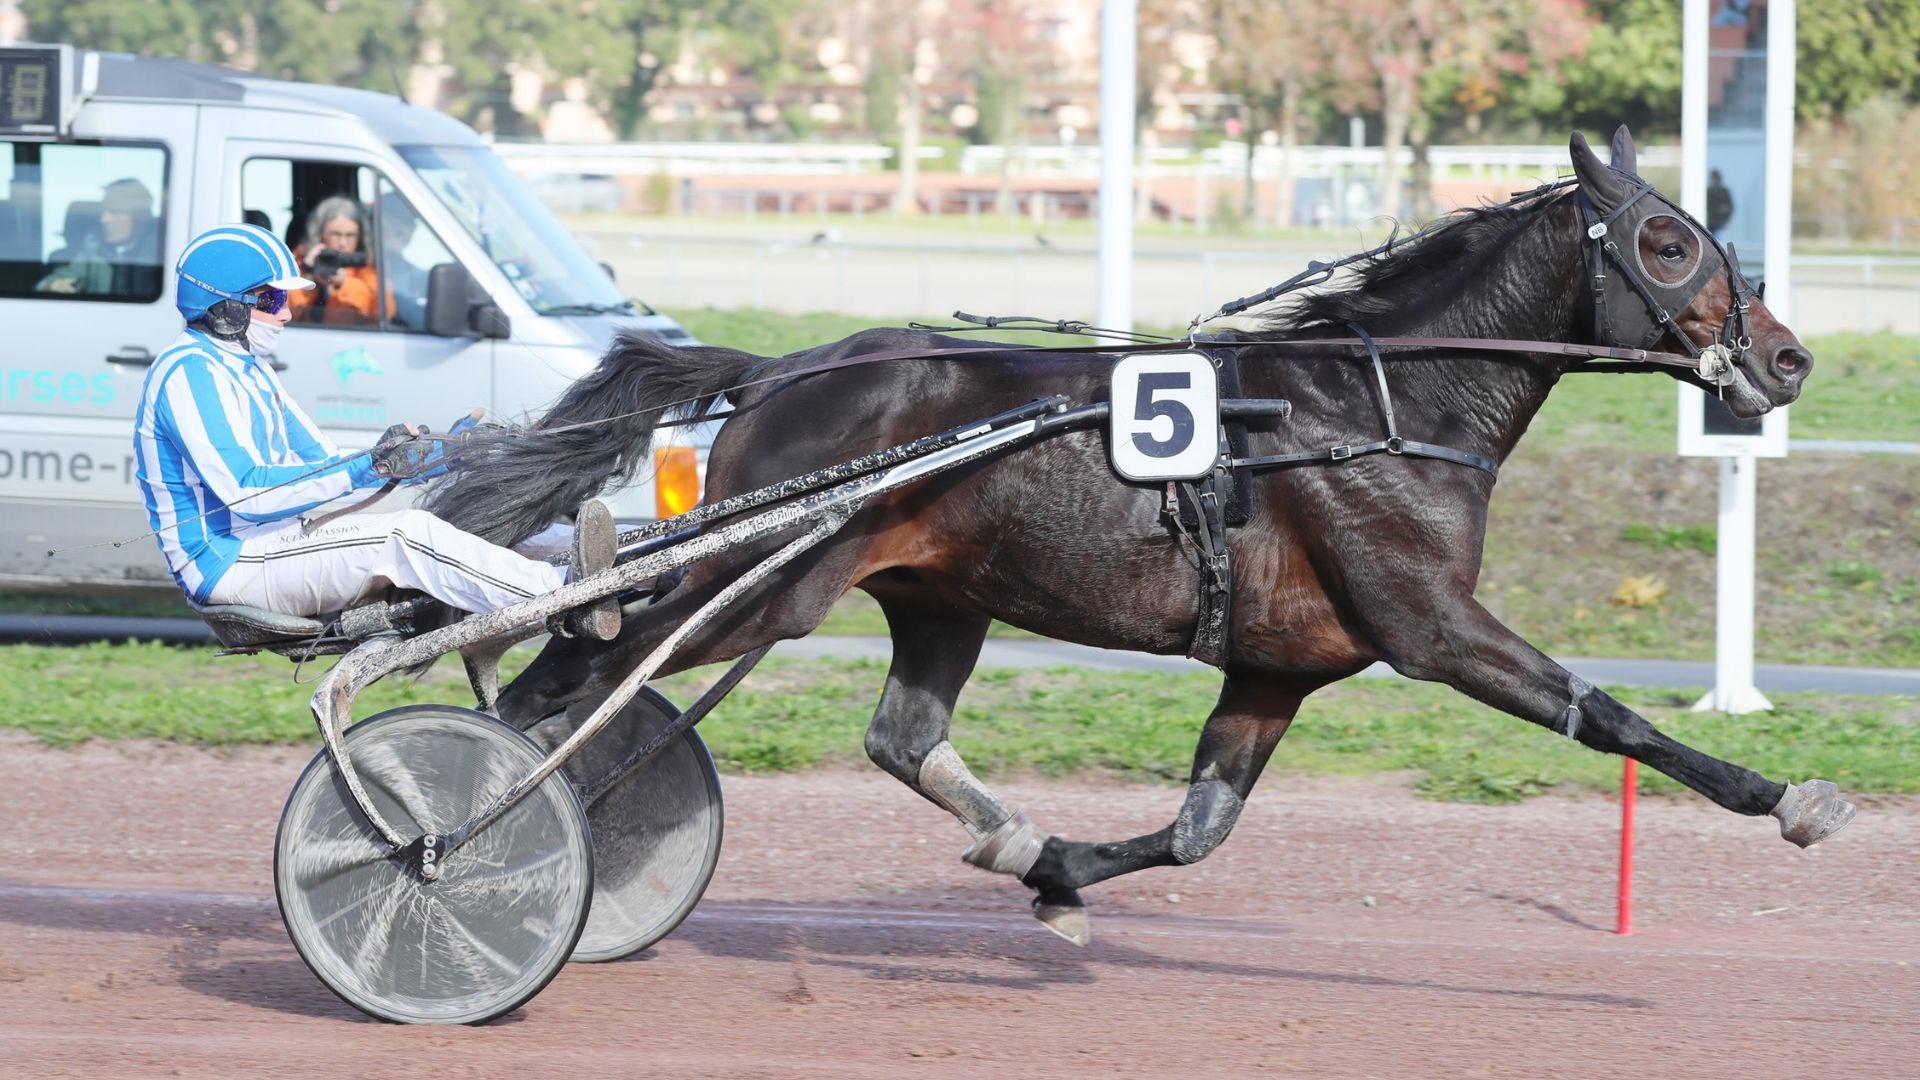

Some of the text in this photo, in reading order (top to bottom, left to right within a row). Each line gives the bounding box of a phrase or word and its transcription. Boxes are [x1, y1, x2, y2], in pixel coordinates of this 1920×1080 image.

[0, 368, 116, 405] rses
[1131, 371, 1195, 458] 5
[754, 504, 806, 532] Bazire
